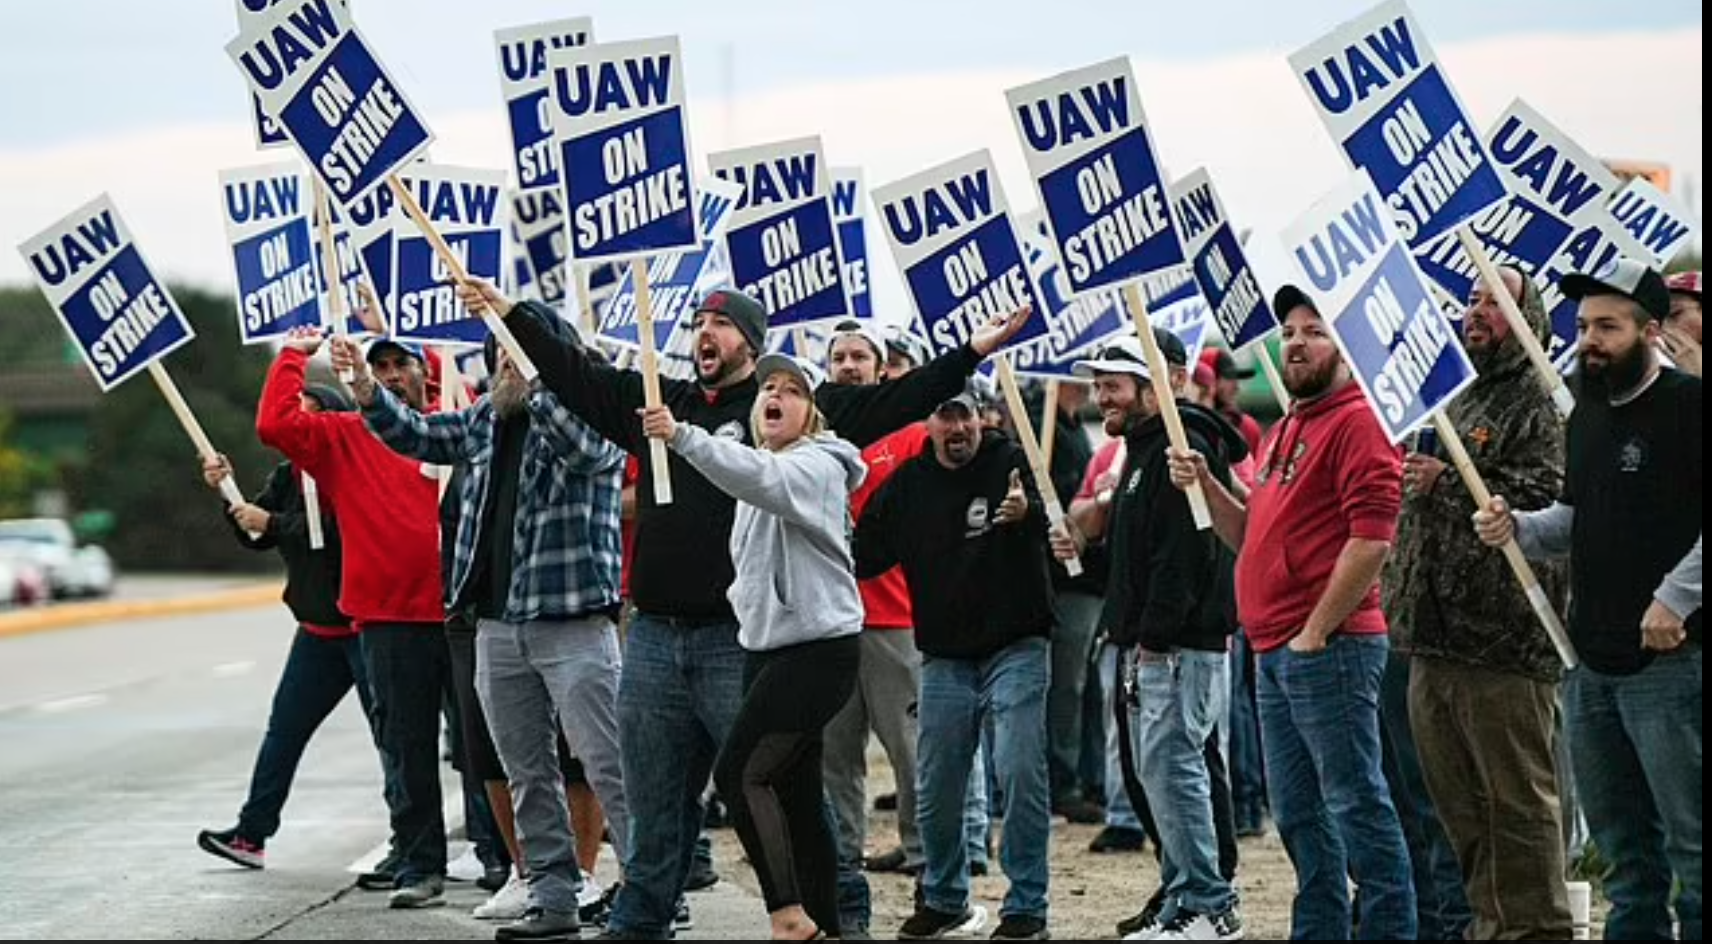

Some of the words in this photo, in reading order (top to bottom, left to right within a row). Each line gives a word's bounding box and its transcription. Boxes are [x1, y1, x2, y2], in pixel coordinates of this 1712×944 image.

[240, 0, 340, 89] UAW
[1304, 16, 1421, 113] UAW
[311, 65, 356, 127] ON
[554, 54, 671, 116] UAW
[1017, 75, 1130, 151] UAW
[321, 77, 403, 194] STRIKE
[602, 127, 648, 184] ON
[1382, 98, 1432, 166] ON
[1489, 115, 1602, 216] UAW
[225, 174, 298, 223] UAW
[574, 164, 686, 250] STRIKE
[883, 168, 992, 245] UAW
[1077, 153, 1122, 215] ON
[1387, 120, 1482, 241] STRIKE
[30, 210, 120, 285] UAW
[260, 232, 289, 278] ON
[761, 217, 800, 267] ON
[1064, 184, 1168, 283] STRIKE
[1295, 193, 1387, 291] UAW
[1472, 198, 1535, 246] ON
[1611, 190, 1689, 254] UAW
[89, 270, 128, 321] ON
[246, 263, 316, 330] STRIKE
[943, 239, 988, 298] ON
[1206, 242, 1232, 291] ON
[90, 282, 168, 378] STRIKE
[1216, 265, 1261, 344] STRIKE
[1365, 275, 1406, 346] ON
[1373, 298, 1450, 424] STRIKE
